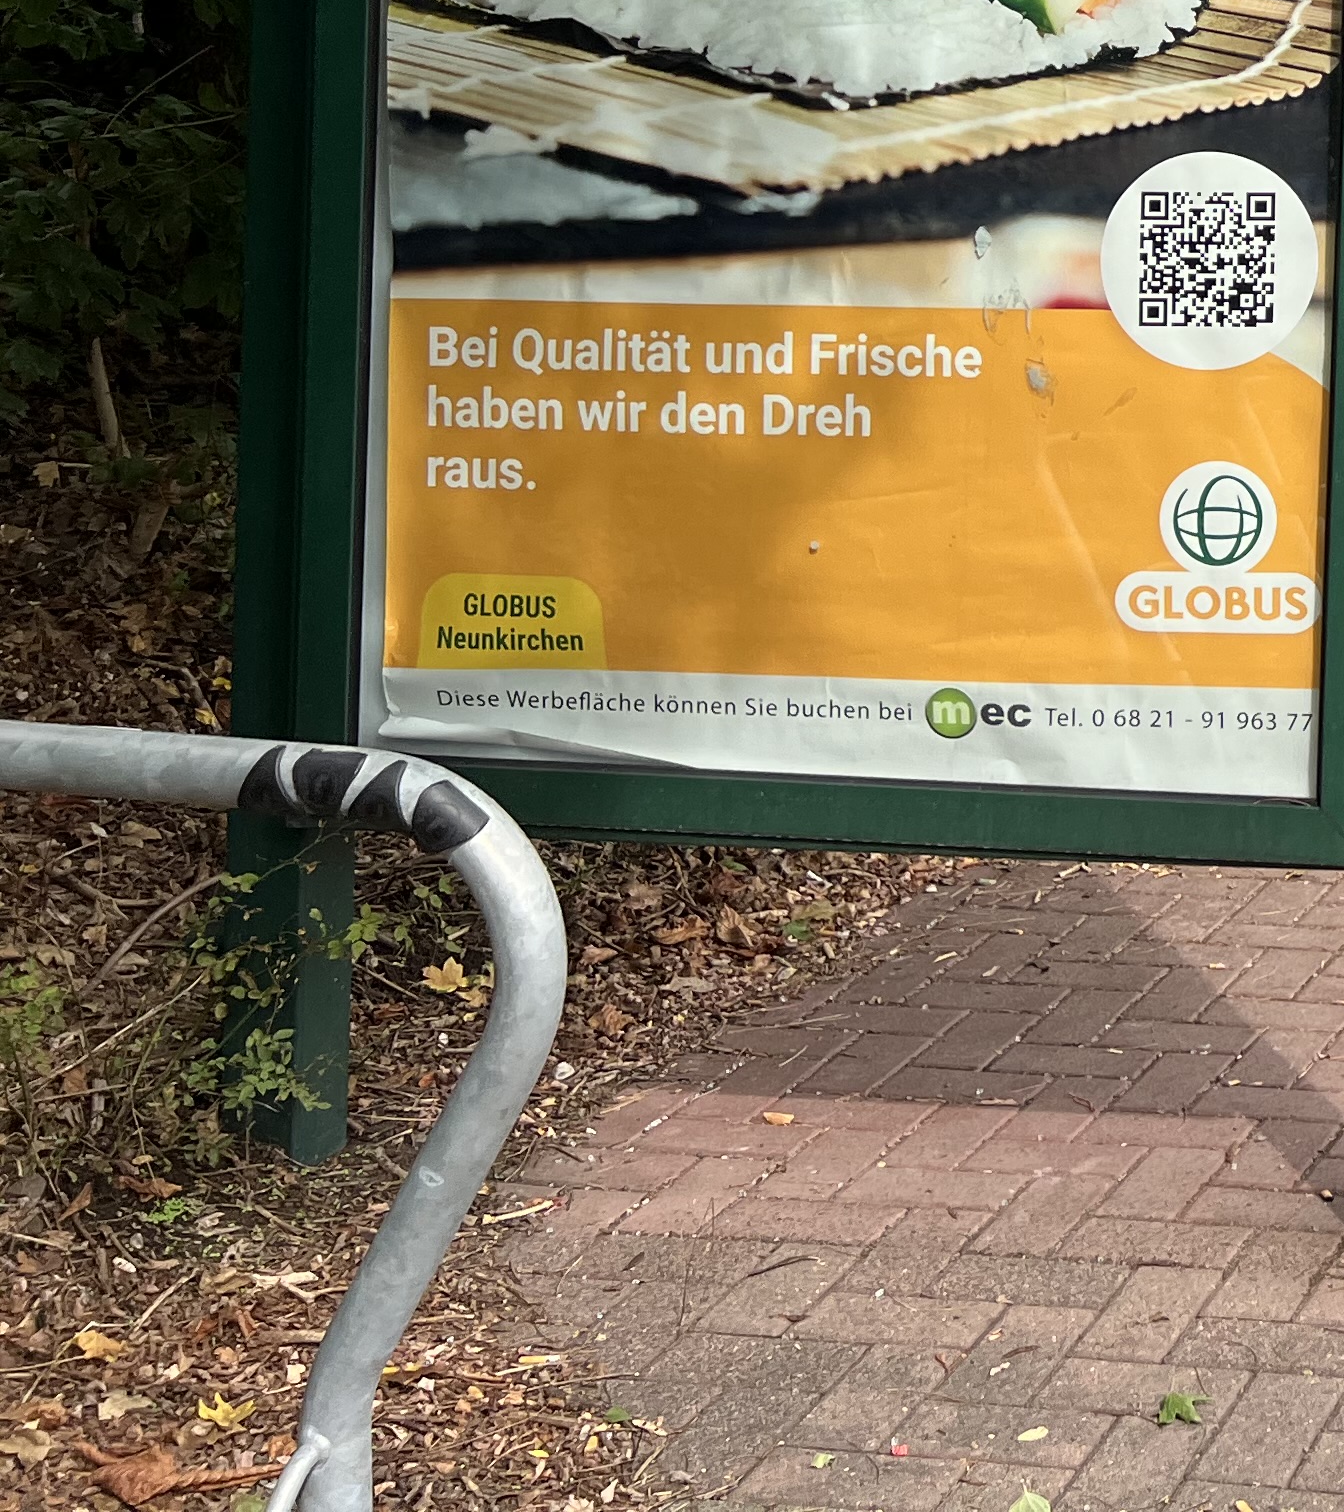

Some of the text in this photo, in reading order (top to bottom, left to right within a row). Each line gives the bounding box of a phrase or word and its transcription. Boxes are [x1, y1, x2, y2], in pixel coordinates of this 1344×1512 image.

[429, 326, 983, 378] Bei Qualität und Frische
[427, 384, 871, 437] haben wir den Dreh
[427, 456, 537, 490] raus.
[463, 593, 557, 618] GLOBUS
[1128, 585, 1308, 621] GLOBUS
[437, 626, 584, 651] Neunkirchen
[437, 690, 499, 708] Diese
[506, 690, 645, 713] Werbefläche
[654, 694, 736, 715] können
[745, 697, 777, 717] Sie
[787, 698, 869, 719] buchen
[879, 701, 912, 721] bei
[929, 696, 1032, 730] mec
[1045, 708, 1083, 727] Tel.
[1092, 709, 1105, 727] 0
[1114, 709, 1141, 728] 68
[1150, 710, 1174, 728] 21
[1202, 711, 1225, 729] 91
[1237, 712, 1277, 731] 963
[1287, 713, 1313, 731] 77
